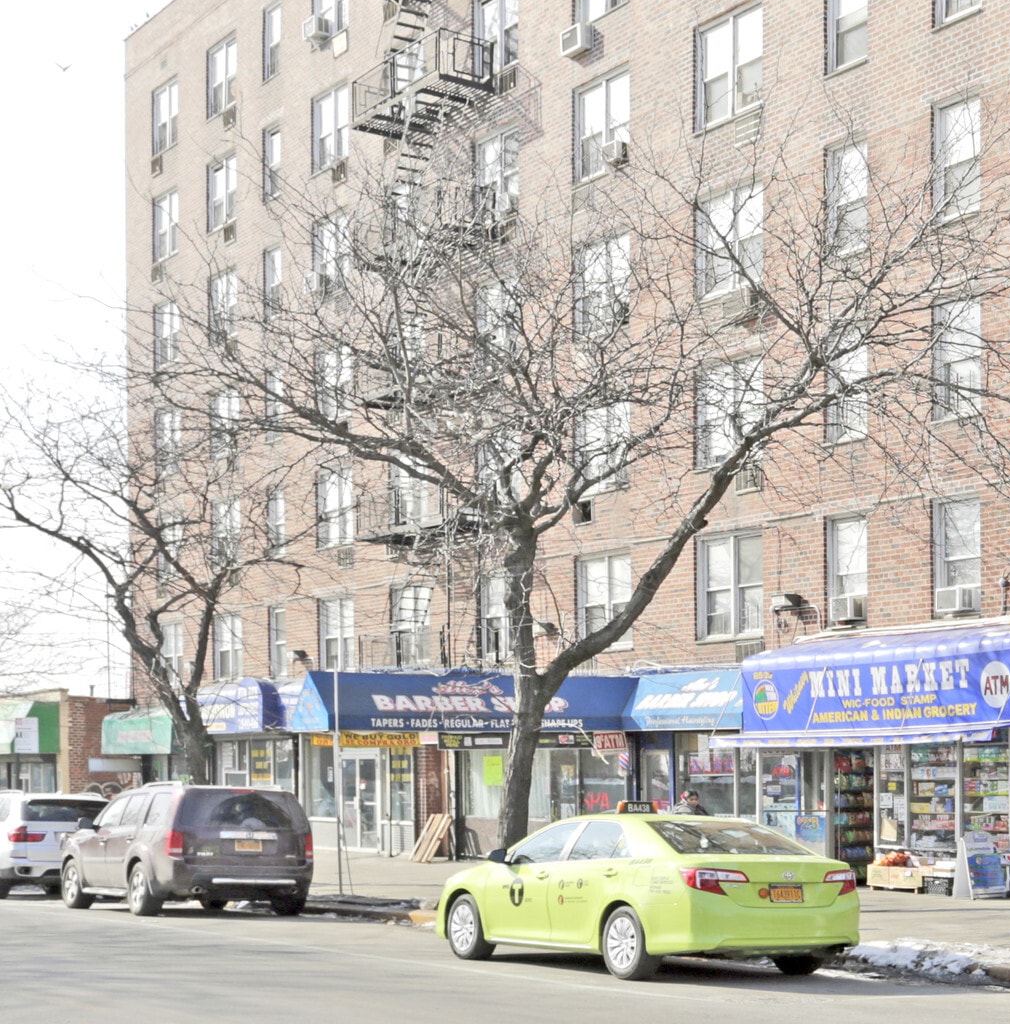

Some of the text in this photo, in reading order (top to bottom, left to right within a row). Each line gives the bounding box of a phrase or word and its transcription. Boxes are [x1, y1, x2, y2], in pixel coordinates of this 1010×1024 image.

[809, 667, 863, 698] MINI
[870, 658, 971, 696] MARKET
[984, 674, 1010, 696] ATM
[371, 694, 491, 713] BARBER
[842, 694, 937, 709] WIC-FOOD STAMP
[813, 703, 978, 724] AMERICAN & INDIAN GROCERY
[370, 718, 404, 728] TAPERS
[410, 718, 438, 728] FADES
[444, 718, 485, 729] REGULAR
[604, 733, 625, 749] ATM
[628, 804, 650, 813] BA438
